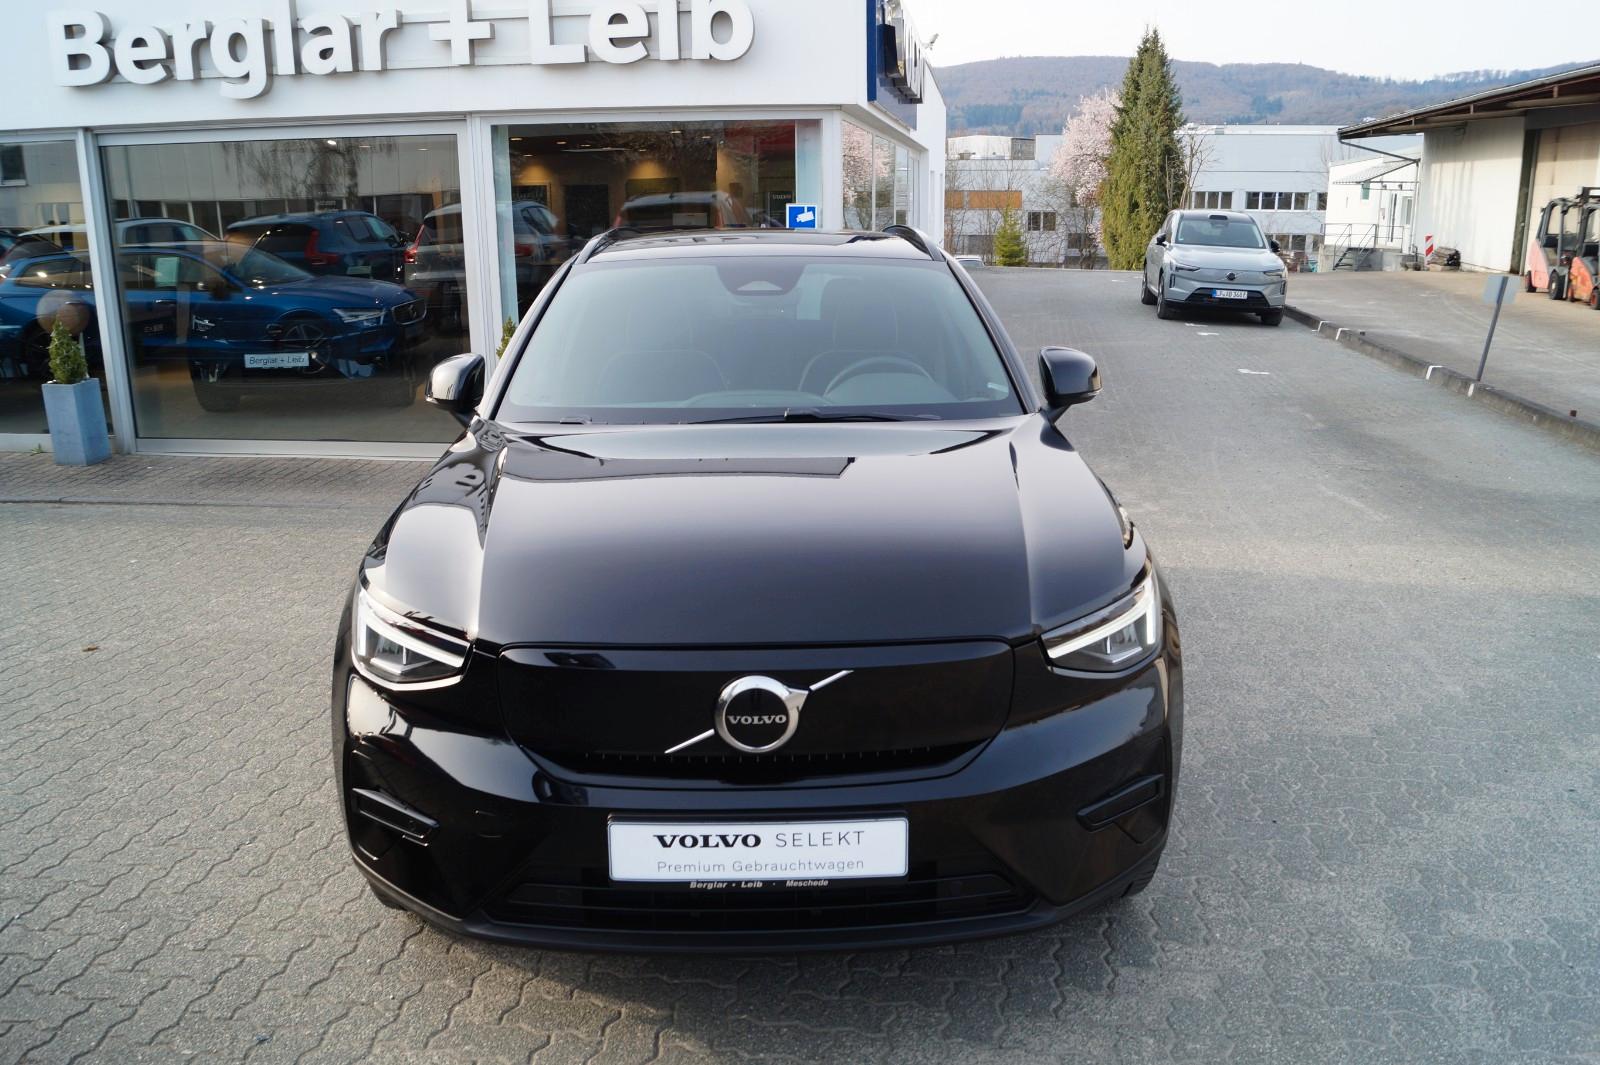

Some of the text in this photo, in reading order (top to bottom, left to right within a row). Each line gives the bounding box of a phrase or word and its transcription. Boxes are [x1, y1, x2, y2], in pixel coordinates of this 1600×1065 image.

[48, 0, 755, 99] Berglar + Leib
[727, 714, 787, 725] VOLVO
[653, 830, 865, 849] VOLVO SELEKT
[657, 859, 864, 873] Premium Gebrauchtwagen
[689, 879, 829, 890] Berglar Leib Meschede
